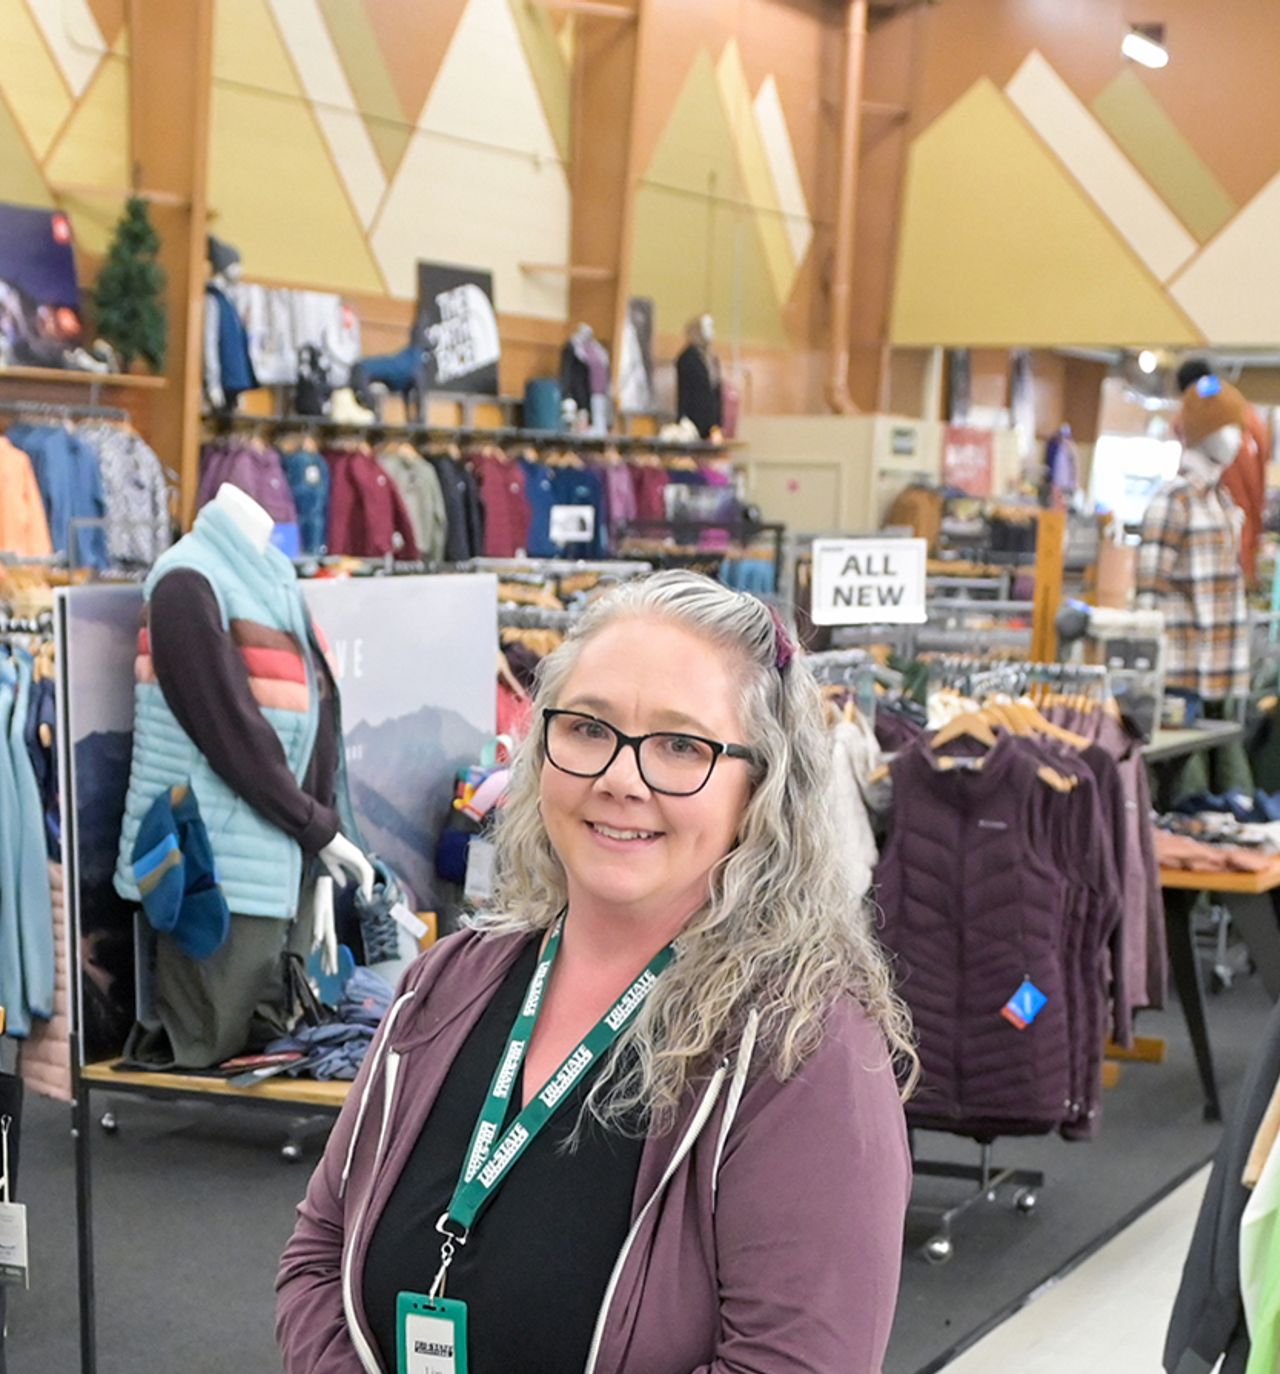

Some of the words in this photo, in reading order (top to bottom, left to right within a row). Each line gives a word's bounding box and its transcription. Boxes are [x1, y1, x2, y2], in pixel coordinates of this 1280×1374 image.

[841, 554, 897, 576] ALL
[832, 585, 905, 607] NEW
[604, 969, 655, 1027] TRI-STATE
[538, 1044, 590, 1104] TRI-STATE
[477, 1122, 525, 1184] TRI-STATE
